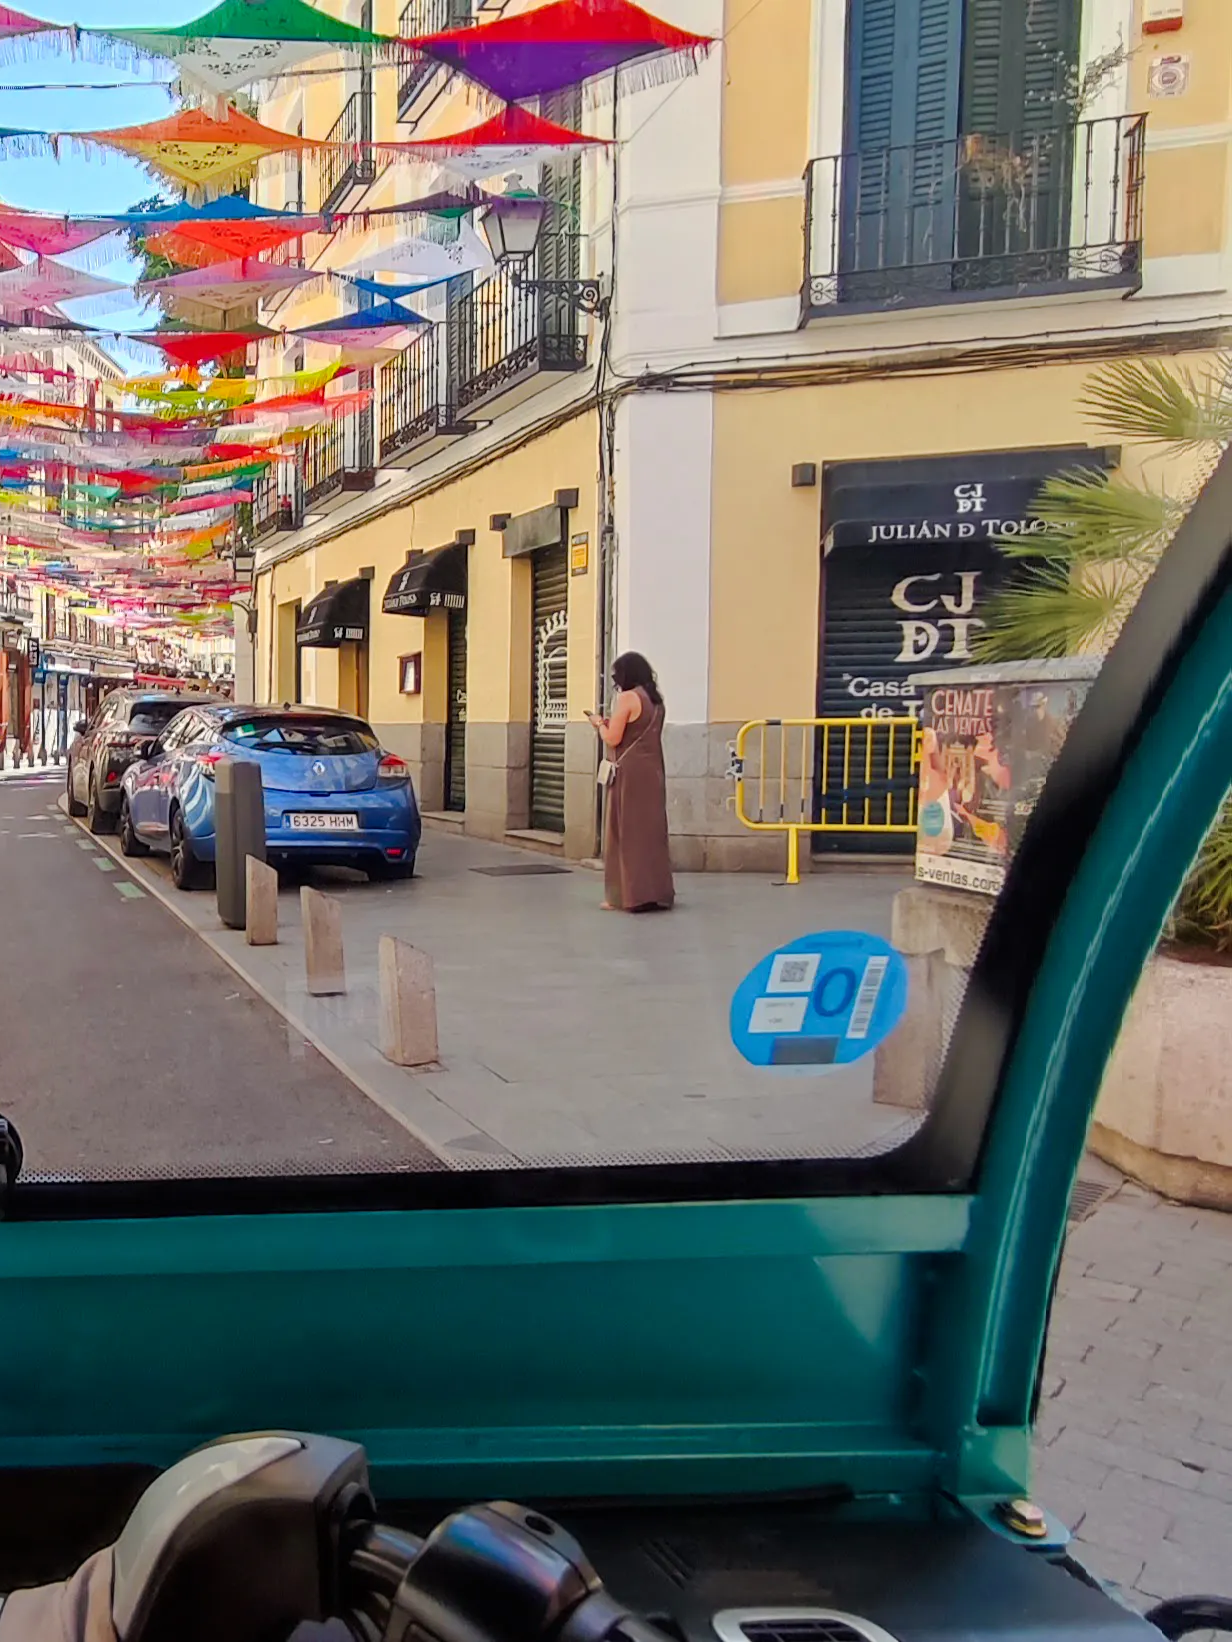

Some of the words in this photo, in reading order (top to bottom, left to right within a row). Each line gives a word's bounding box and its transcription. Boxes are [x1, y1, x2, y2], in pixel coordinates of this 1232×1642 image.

[868, 519, 951, 542] JULIÁN
[848, 676, 915, 697] Casa
[931, 688, 994, 717] CENATE
[931, 716, 950, 734] LAS
[293, 815, 326, 827] 6325
[329, 815, 354, 827] HHM
